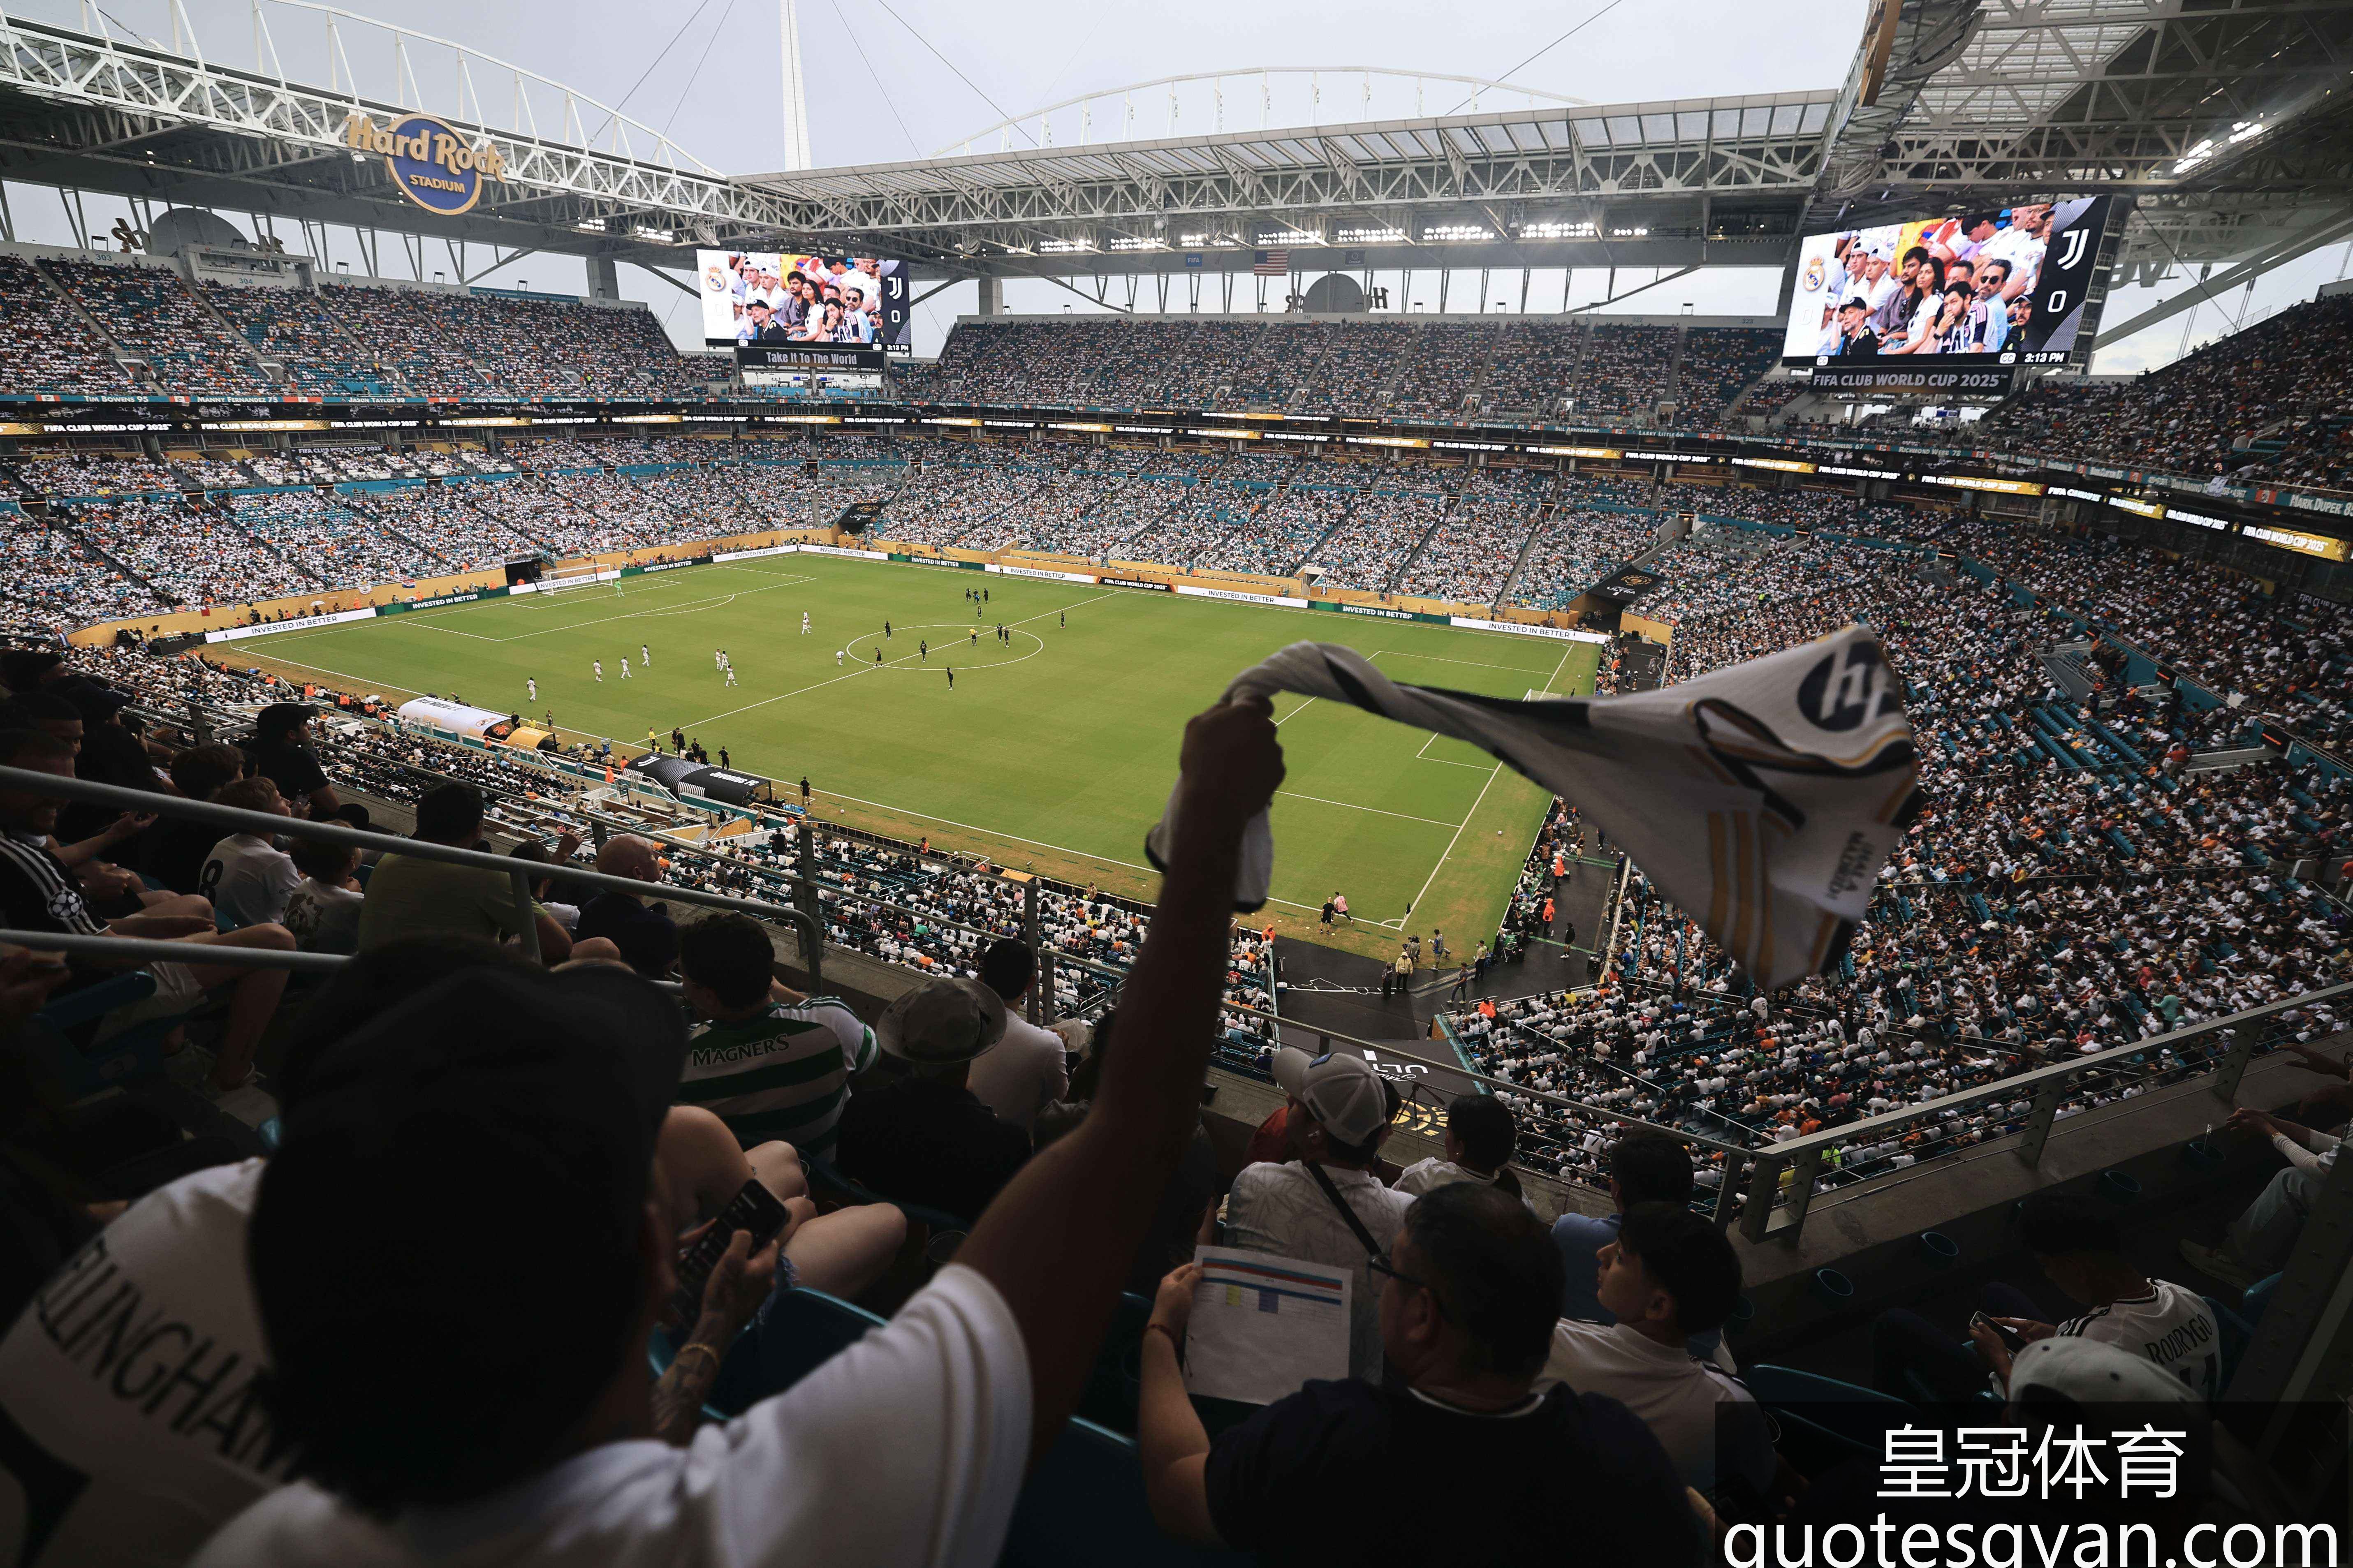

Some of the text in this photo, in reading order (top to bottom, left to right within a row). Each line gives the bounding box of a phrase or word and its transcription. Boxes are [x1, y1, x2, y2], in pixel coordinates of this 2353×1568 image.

[345, 115, 506, 183] Hard Rock
[409, 174, 465, 193] STADIUM
[2047, 290, 2067, 313] 0
[891, 310, 901, 323] 0
[767, 352, 857, 365] Take It To The World
[2024, 352, 2065, 363] 3:13 PM
[1813, 375, 1837, 388] FIFA
[1841, 375, 1873, 388] CLUB
[1876, 374, 1925, 388] WORLD
[1927, 374, 1958, 388] CUP
[1955, 479, 1981, 488] WORLD
[2290, 494, 2314, 509] MARK
[2314, 498, 2343, 514] DUPER
[2242, 525, 2256, 538] FIFA
[2256, 528, 2271, 541] CLUB
[2270, 531, 2293, 545] WORLD
[2293, 535, 2307, 548] CUP
[1209, 590, 1239, 599] INVESTED
[1250, 594, 1274, 603] BETTER
[1607, 585, 1635, 594] ULTRA
[412, 599, 445, 609] INVESTED
[454, 594, 478, 603] BETTER
[1343, 606, 1376, 615] INVESTED
[1386, 611, 1412, 620] BETTER
[252, 623, 294, 634] INVESTED
[307, 616, 337, 625] BETTER
[1489, 623, 1527, 633] INVESTED
[1540, 627, 1570, 638] BETTER
[709, 772, 748, 783] Juventus
[200, 859, 223, 907] 8
[692, 1033, 790, 1067] MAGNERS
[1591, 1135, 1599, 1146] 7
[2145, 1314, 2213, 1365] RODRYGO
